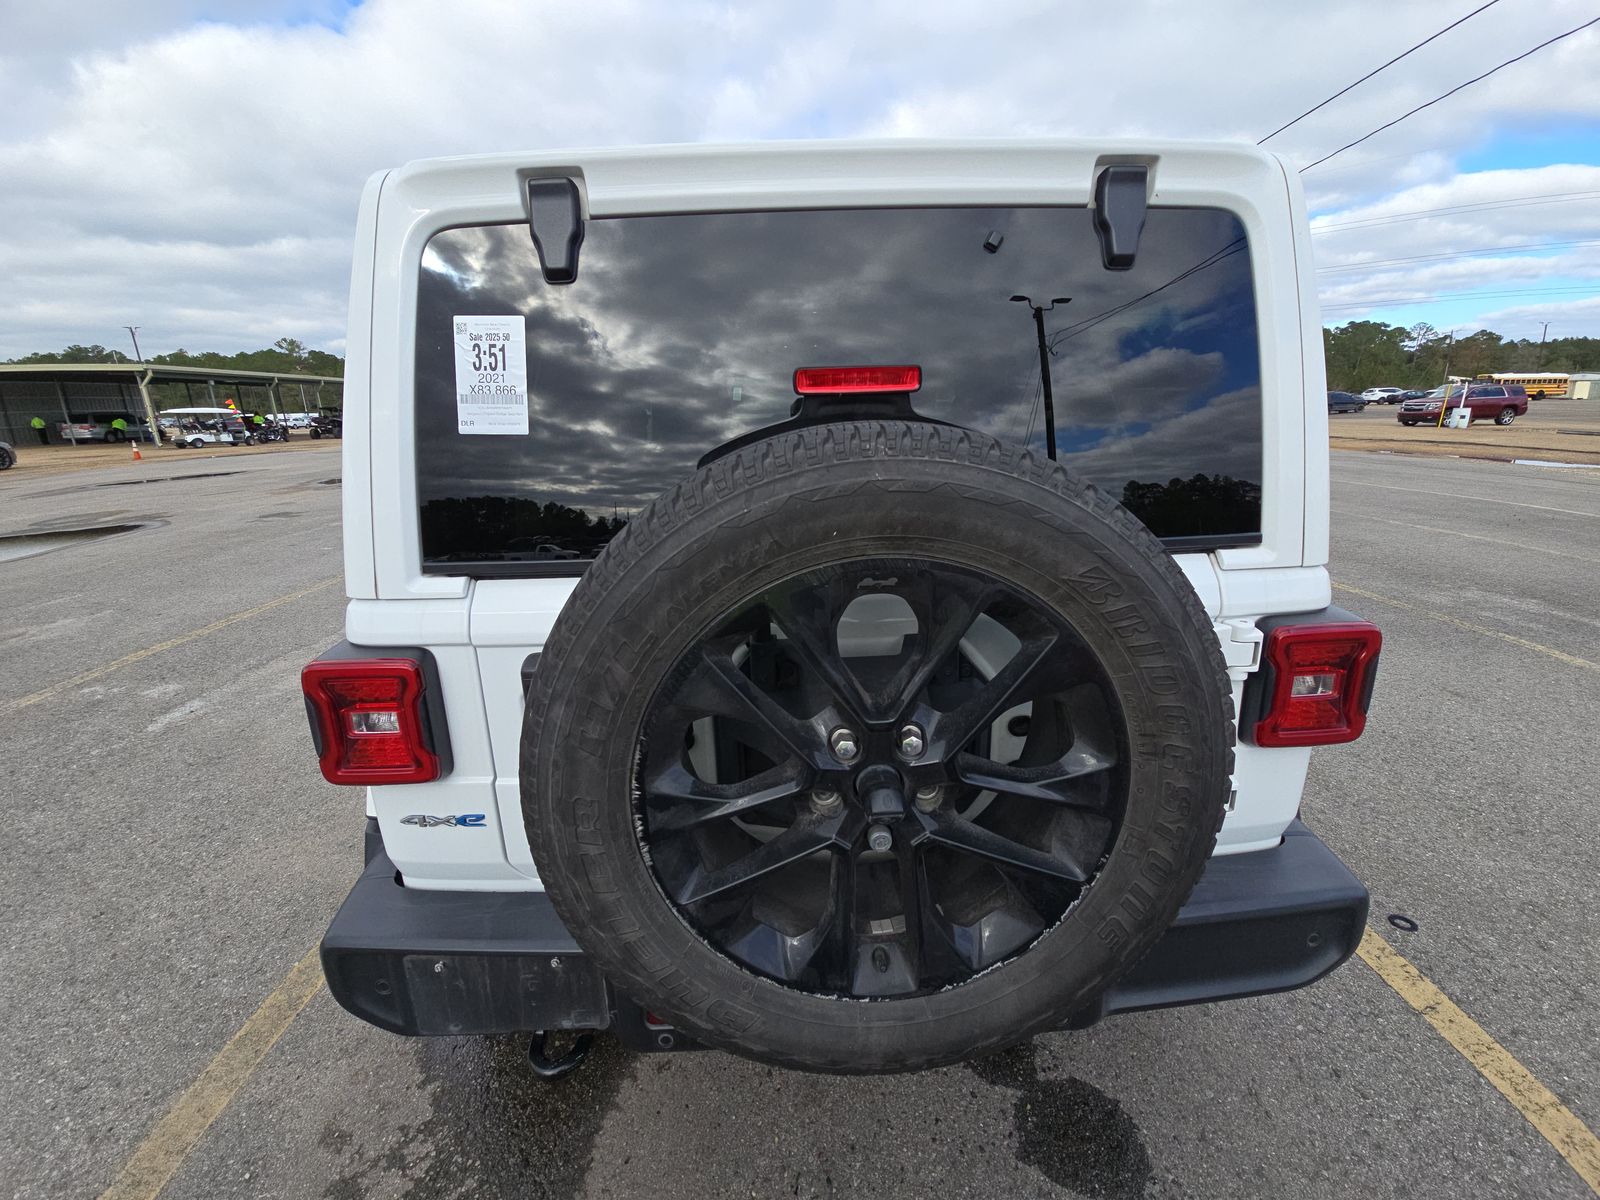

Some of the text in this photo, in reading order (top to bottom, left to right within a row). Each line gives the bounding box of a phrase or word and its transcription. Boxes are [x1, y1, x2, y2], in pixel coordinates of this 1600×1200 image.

[469, 332, 483, 341] Sale
[472, 343, 506, 371] 3:51
[478, 373, 505, 383] 2021
[1062, 564, 1193, 952] BRIDGESTONE
[572, 796, 761, 1034] DUELER
